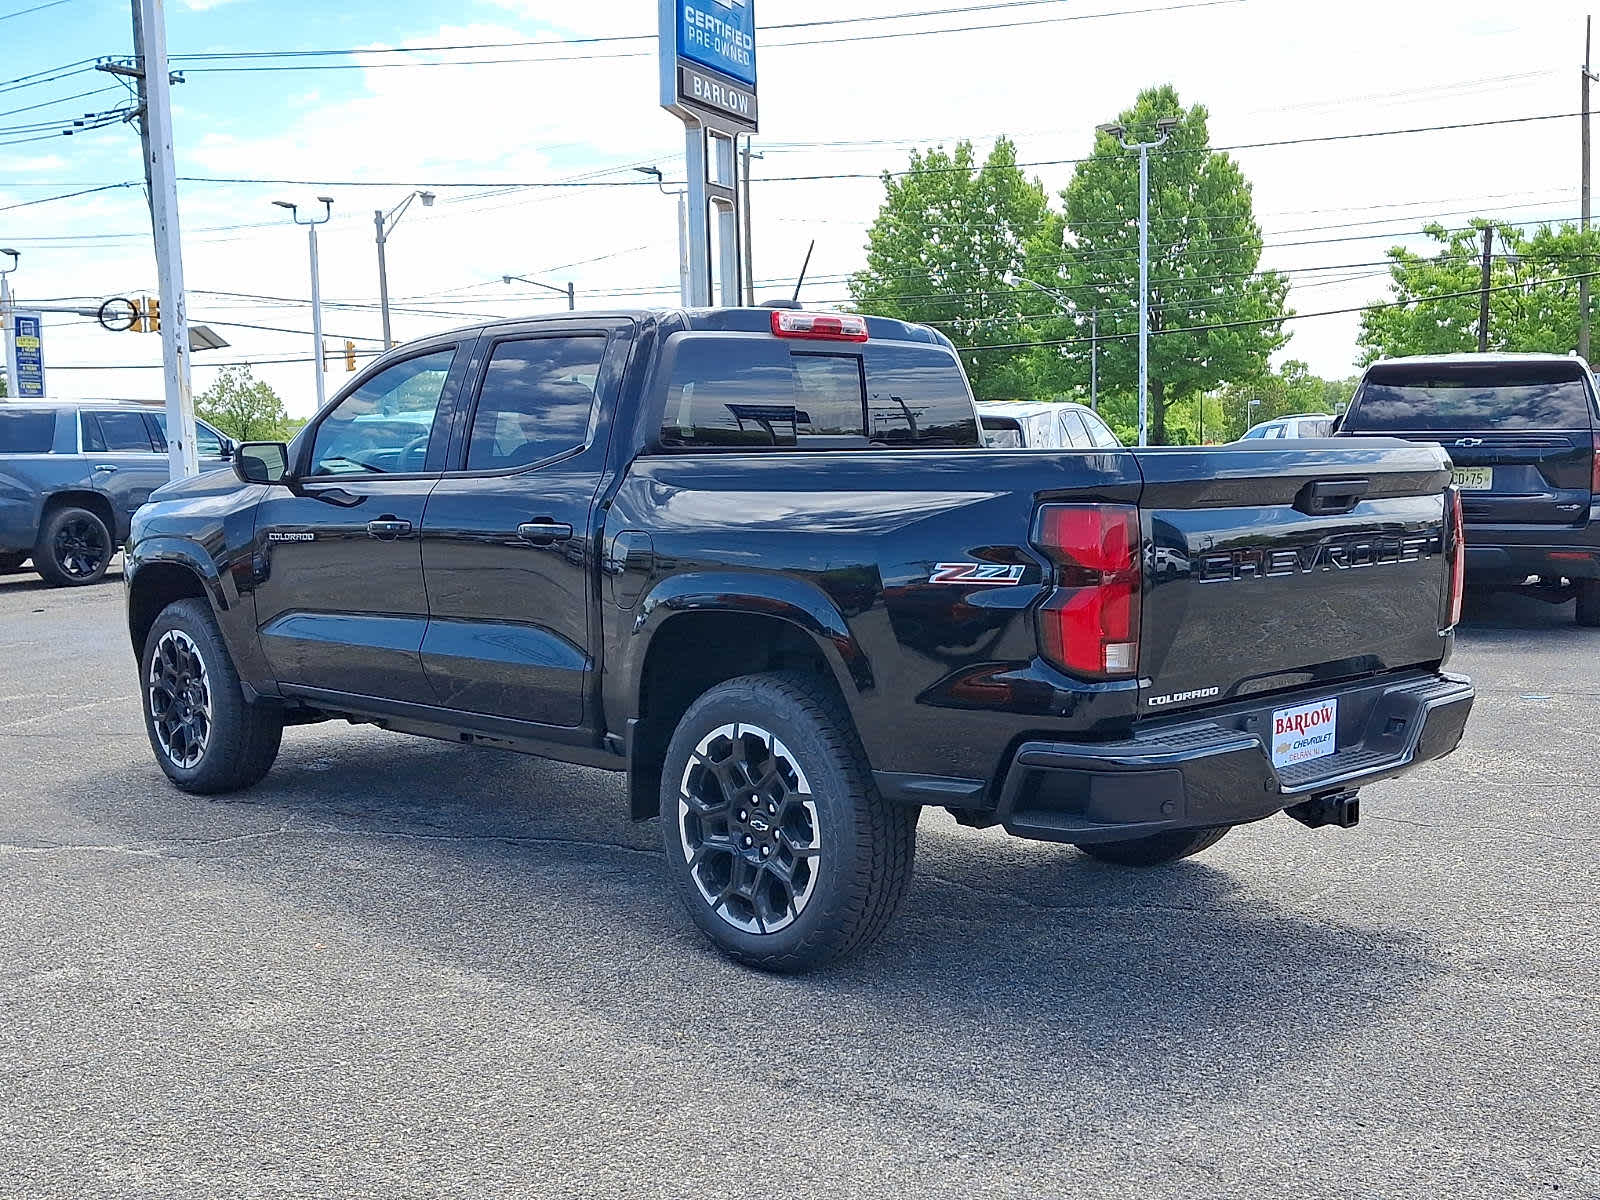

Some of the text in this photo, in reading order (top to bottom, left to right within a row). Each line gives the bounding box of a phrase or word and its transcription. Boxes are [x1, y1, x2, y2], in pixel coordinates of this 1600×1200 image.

[685, 6, 752, 50] CERTIFIED
[688, 27, 750, 65] PRE-OWNED
[693, 76, 748, 113] BARLOW
[268, 532, 315, 541] COLORADO
[928, 562, 1026, 585] Z71
[1198, 537, 1439, 584] CHEVROLET
[1148, 686, 1219, 707] COLORADO
[1275, 707, 1334, 736] BARLOW
[1293, 732, 1333, 749] CHEVROLET
